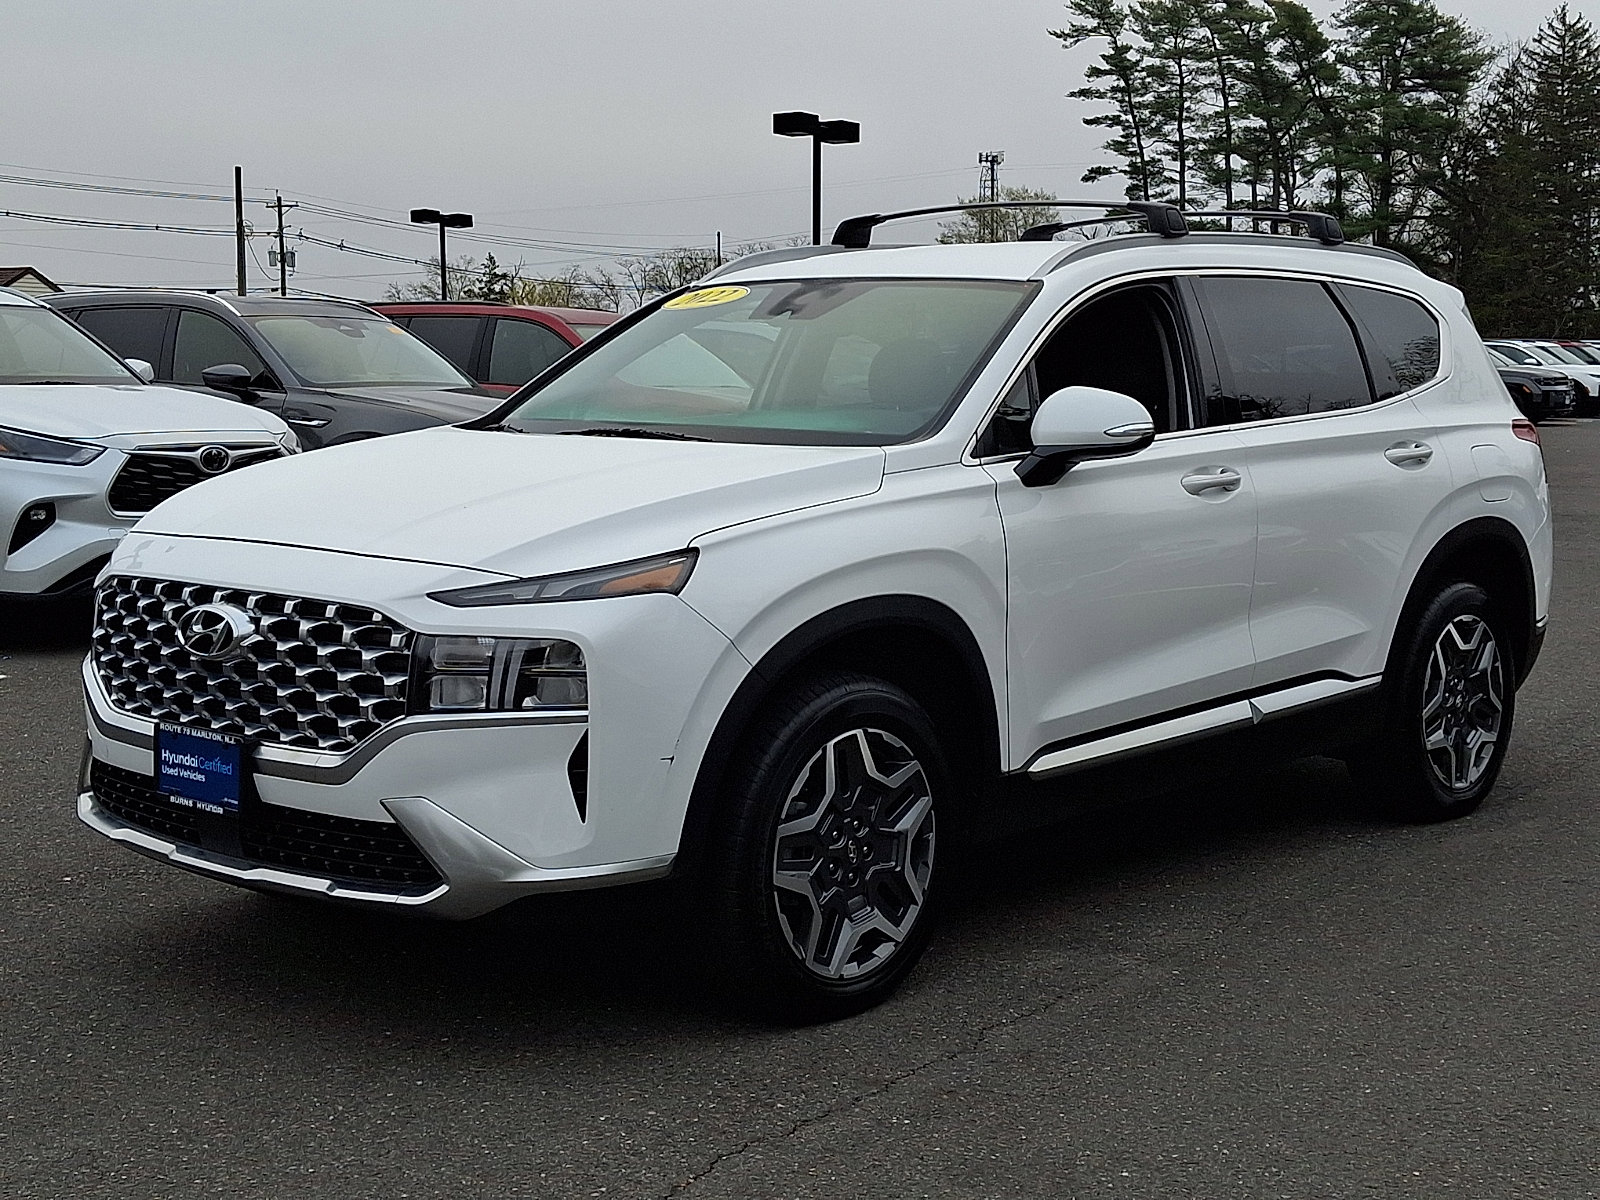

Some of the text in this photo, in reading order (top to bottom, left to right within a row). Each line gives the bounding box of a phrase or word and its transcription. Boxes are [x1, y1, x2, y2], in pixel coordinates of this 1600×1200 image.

[160, 723, 181, 733] ROUTE
[161, 749, 232, 775] Hyundai Certified
[161, 764, 205, 782] Used Vehicles
[170, 795, 193, 807] BURNS
